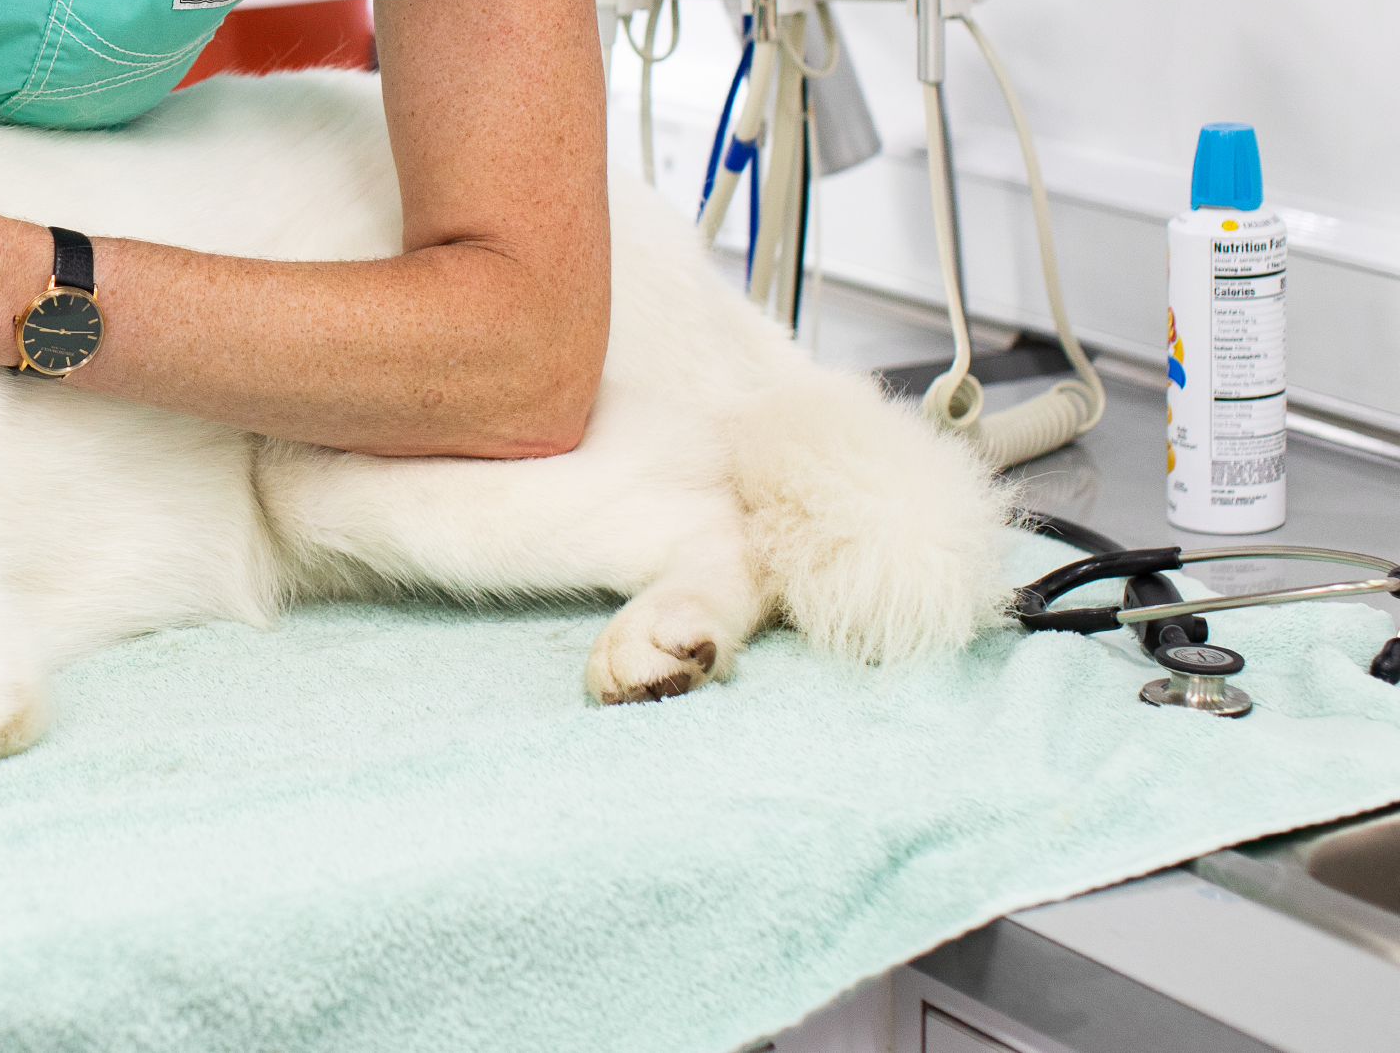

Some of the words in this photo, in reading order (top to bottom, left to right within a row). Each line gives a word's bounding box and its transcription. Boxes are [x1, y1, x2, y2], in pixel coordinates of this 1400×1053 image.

[1214, 239, 1267, 253] Nutrition
[1269, 237, 1286, 250] Fact
[1214, 287, 1256, 296] Calories
